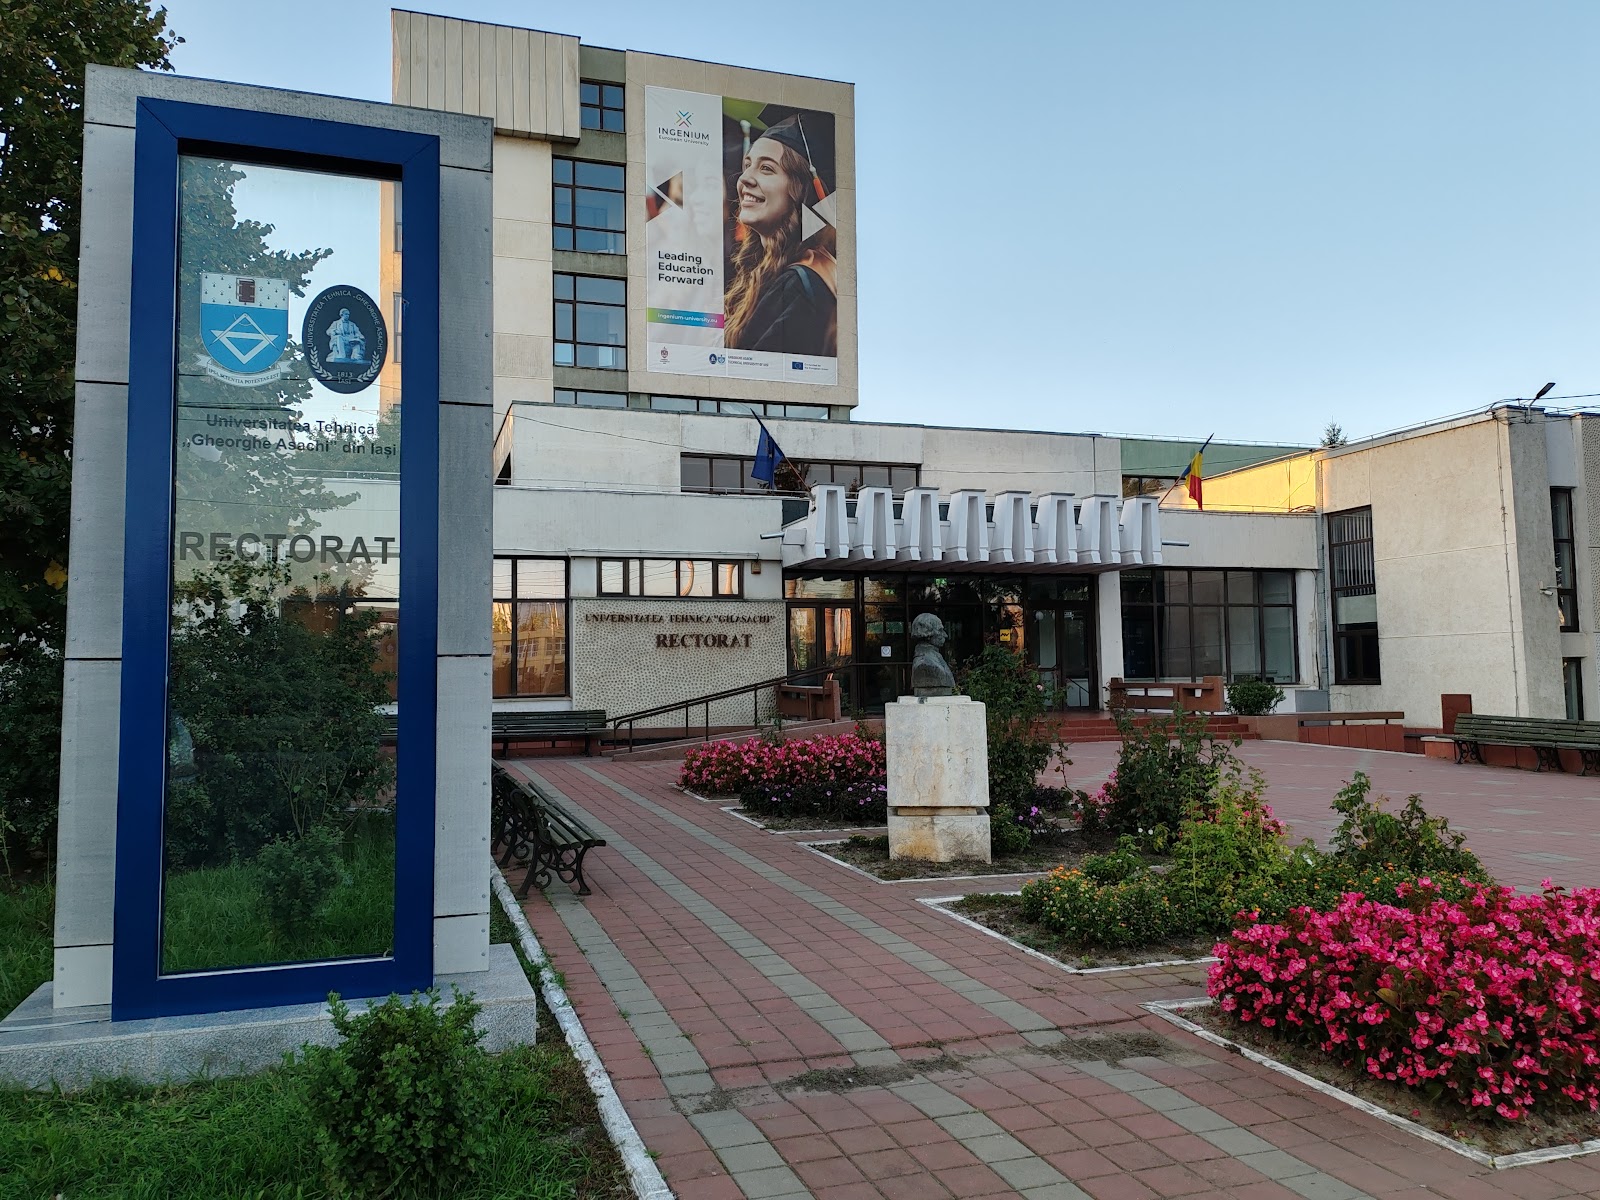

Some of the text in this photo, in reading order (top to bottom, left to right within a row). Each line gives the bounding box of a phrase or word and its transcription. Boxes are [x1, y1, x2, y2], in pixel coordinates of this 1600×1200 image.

[658, 127, 710, 141] INGENIUM
[683, 138, 709, 147] University
[658, 250, 702, 265] Leading
[658, 262, 714, 276] Education
[658, 273, 704, 286] Forward
[307, 302, 324, 348] UNIVERSITATEA
[657, 312, 718, 324] ingenium-university.eu
[206, 413, 375, 436] Universitatea Tehnică
[342, 442, 366, 455] din
[179, 531, 396, 564] RECTORAT
[585, 613, 664, 623] UNIVERSITATEA
[655, 633, 753, 649] RECTORAT
